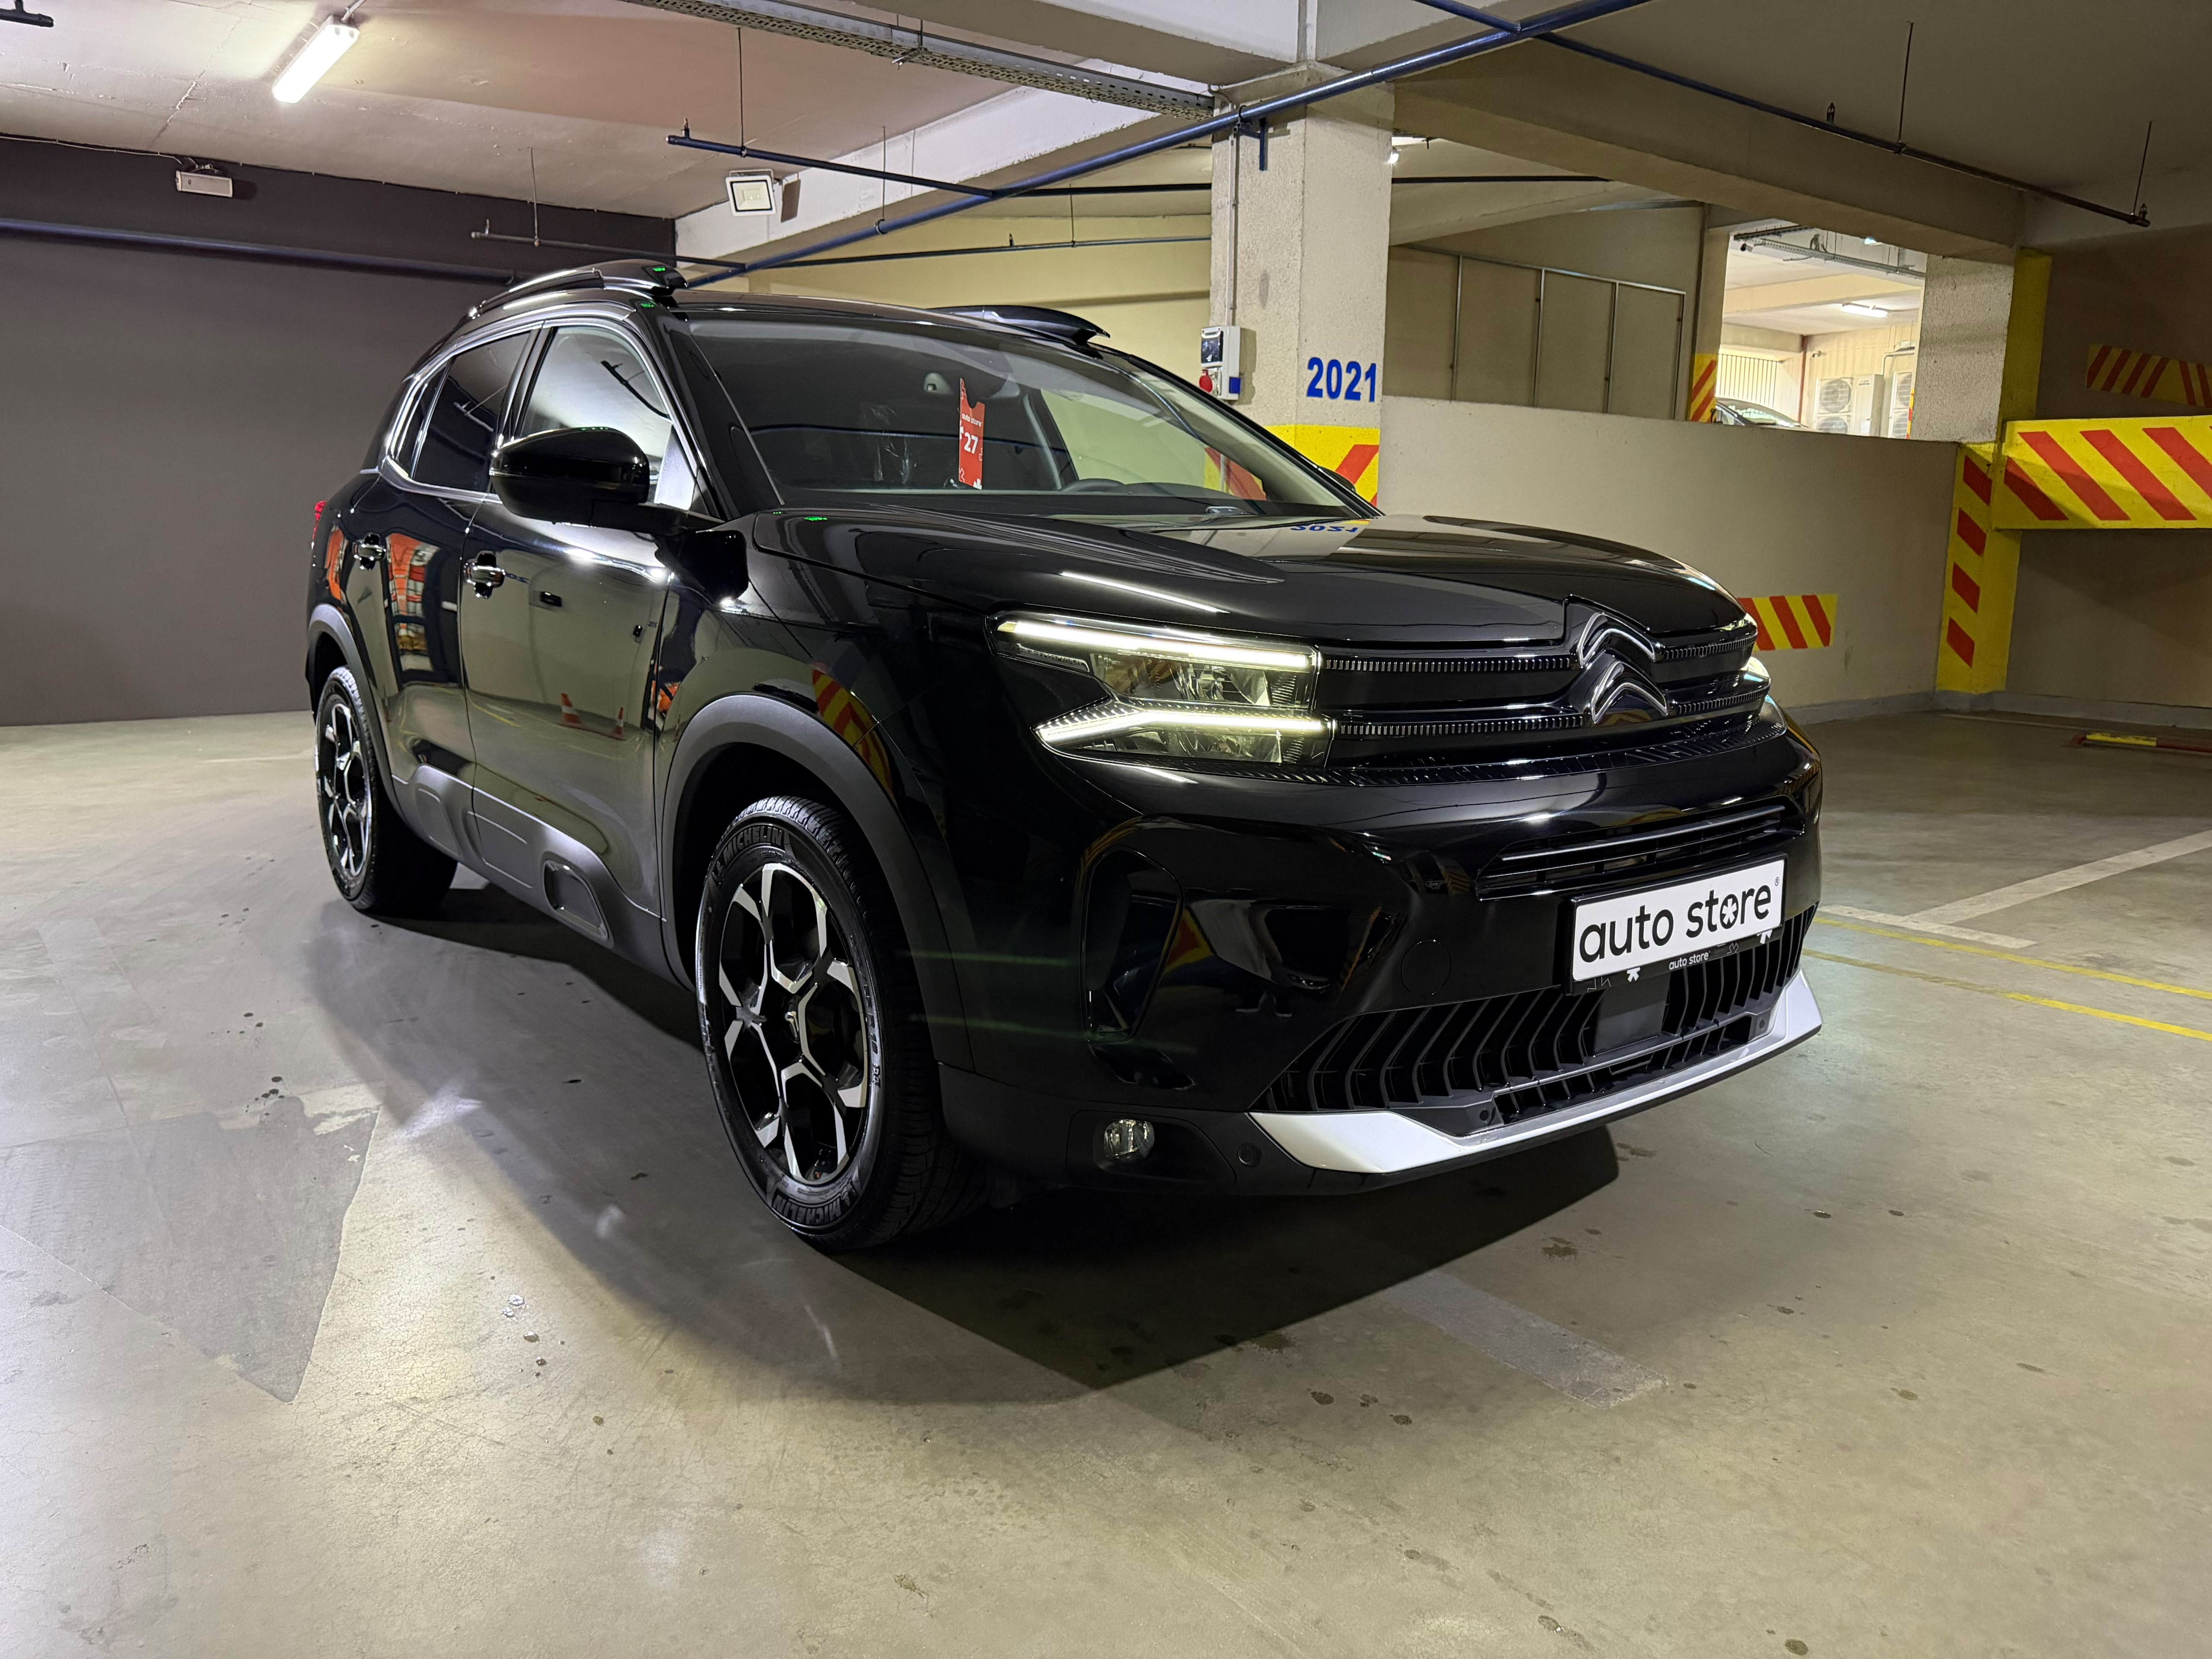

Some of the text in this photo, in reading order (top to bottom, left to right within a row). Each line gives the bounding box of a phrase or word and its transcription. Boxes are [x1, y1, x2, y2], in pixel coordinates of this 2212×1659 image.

[1306, 357, 1376, 402] 2021
[964, 432, 978, 454] 27
[723, 826, 784, 867] MICHELIN
[1579, 884, 1771, 963] auto store
[1669, 952, 1709, 970] auto store
[772, 1194, 842, 1226] MICHELIN
